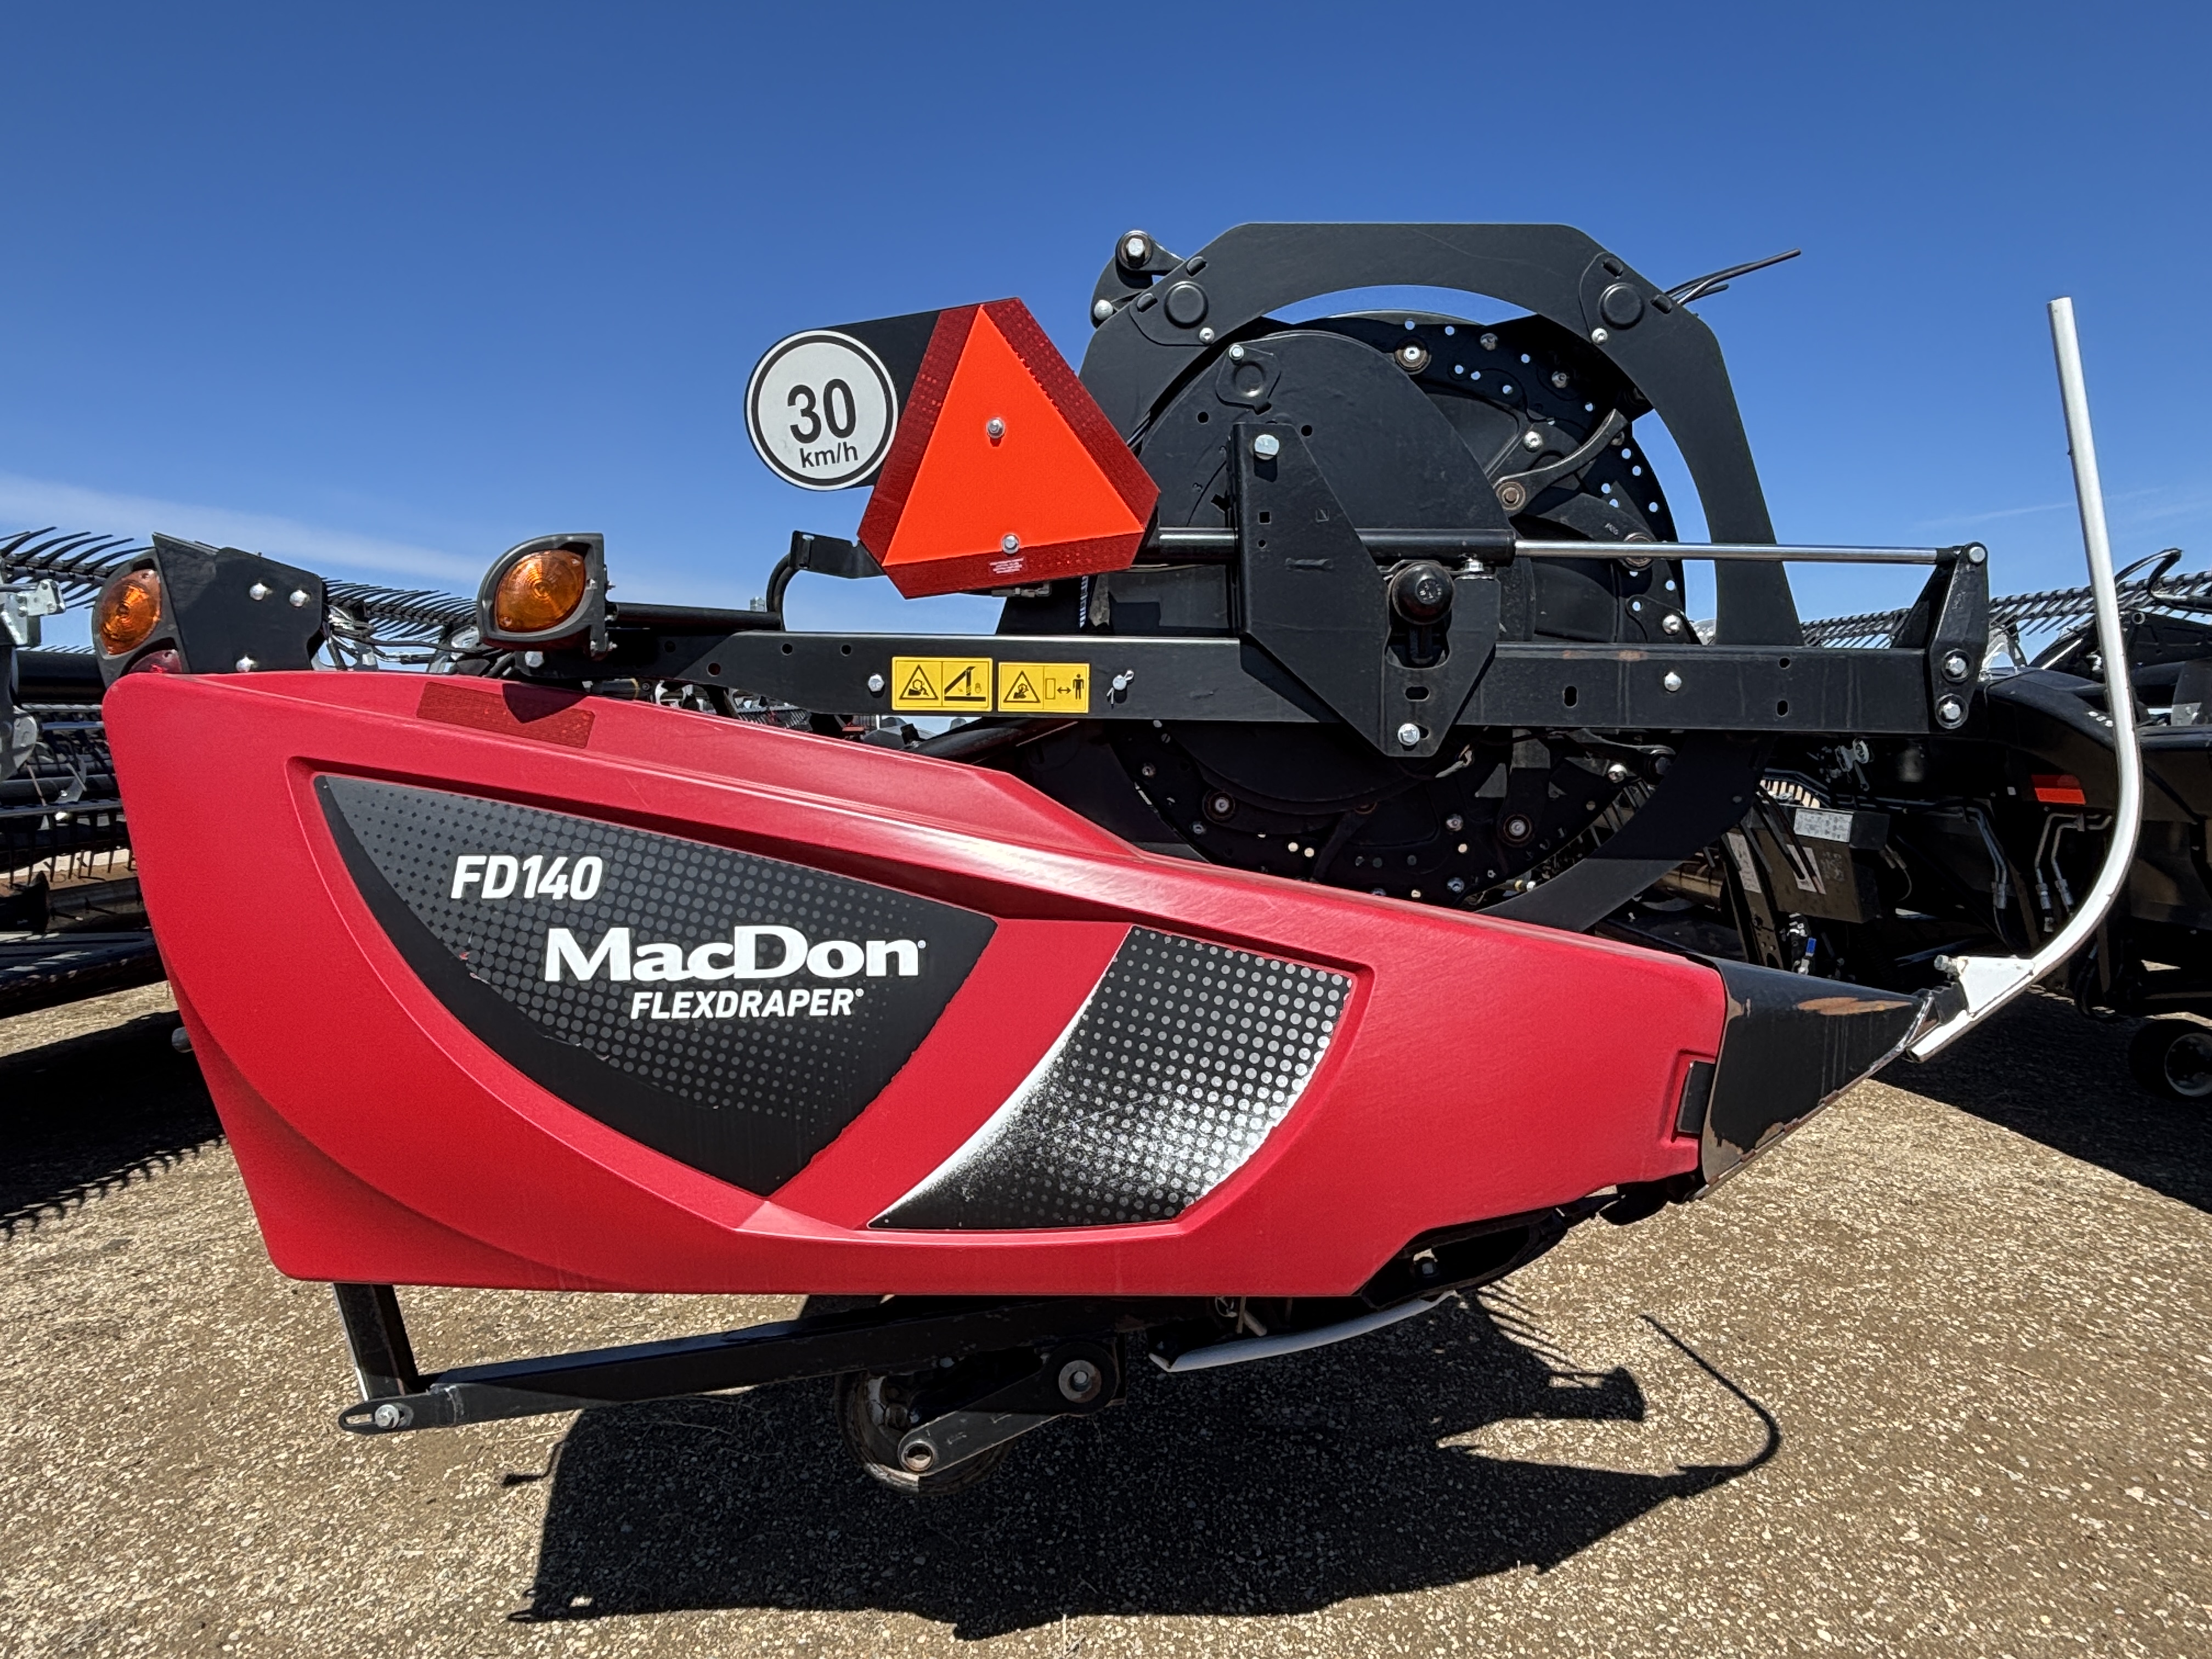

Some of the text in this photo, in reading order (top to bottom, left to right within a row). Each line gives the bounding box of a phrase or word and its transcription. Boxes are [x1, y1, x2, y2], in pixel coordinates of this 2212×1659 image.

[787, 379, 856, 444] 30
[799, 442, 859, 468] km/h
[451, 855, 603, 900] FD140
[544, 926, 918, 981] MacDon
[630, 989, 853, 1020] FLEXDRAPER
